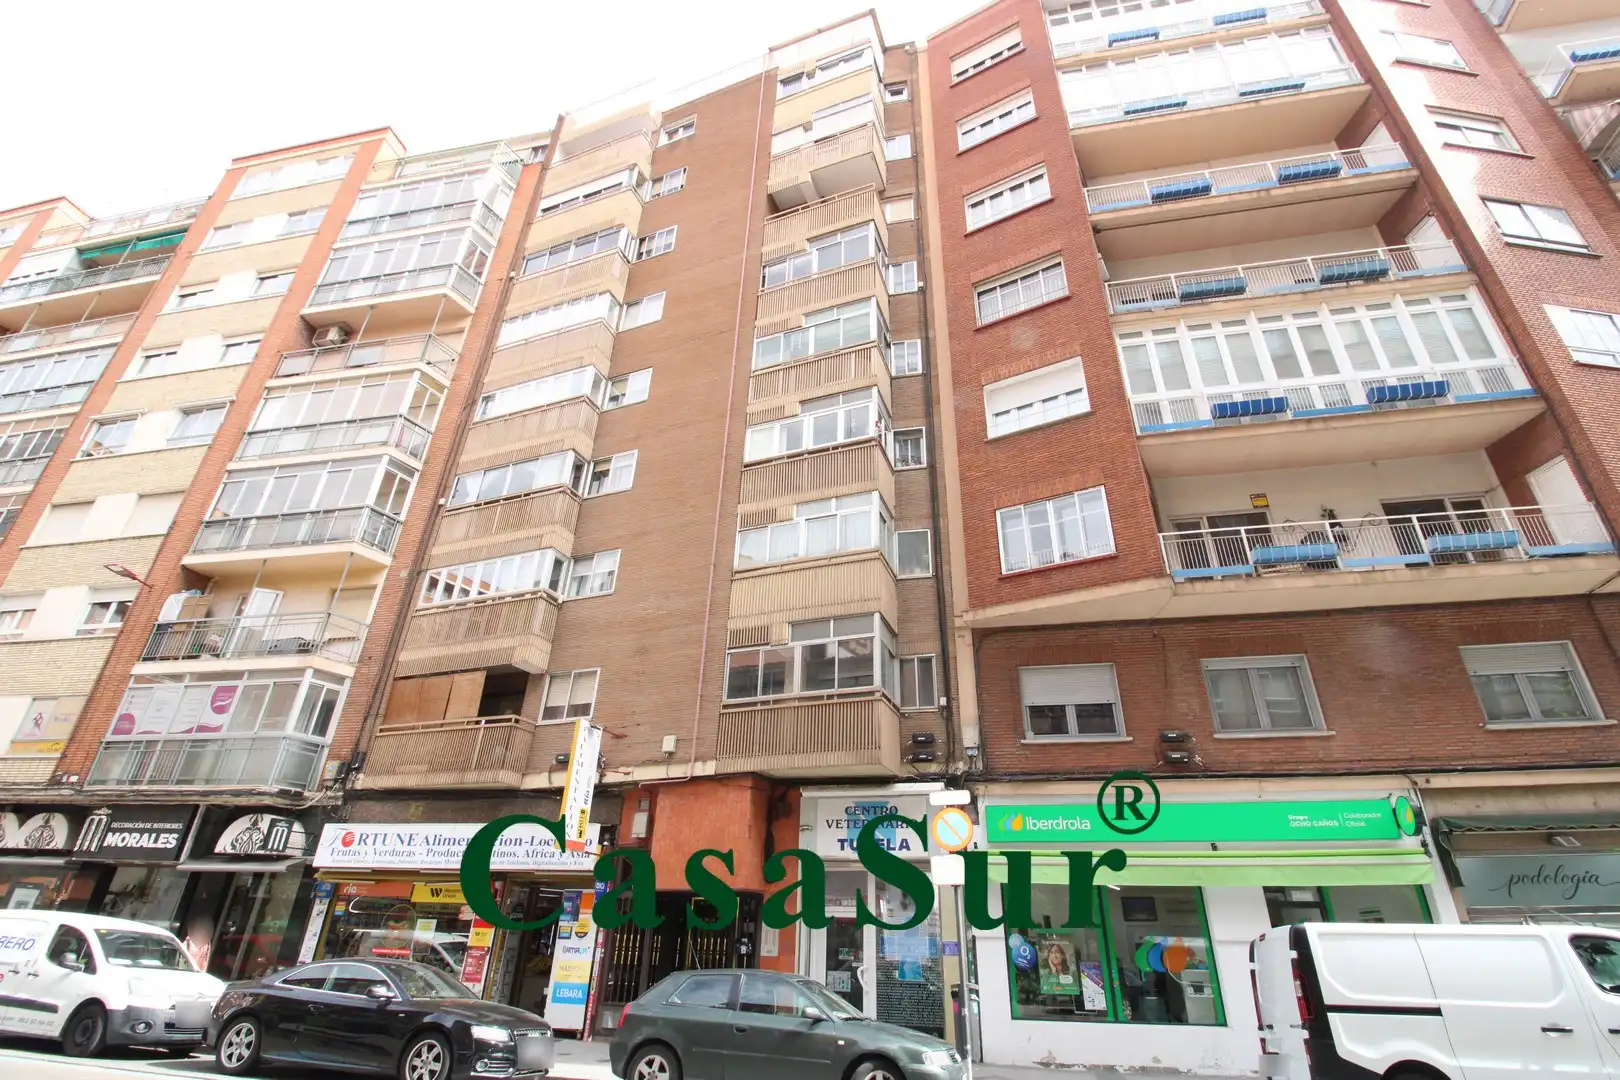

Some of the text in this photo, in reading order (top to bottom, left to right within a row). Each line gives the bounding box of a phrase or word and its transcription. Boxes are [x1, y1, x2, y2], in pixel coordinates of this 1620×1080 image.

[845, 806, 899, 816] CENTRO
[1026, 817, 1091, 831] Iberdrola
[103, 832, 179, 848] MORALES
[330, 847, 361, 857] Frutas
[373, 847, 416, 857] Verduras
[556, 988, 583, 999] LEBARA
